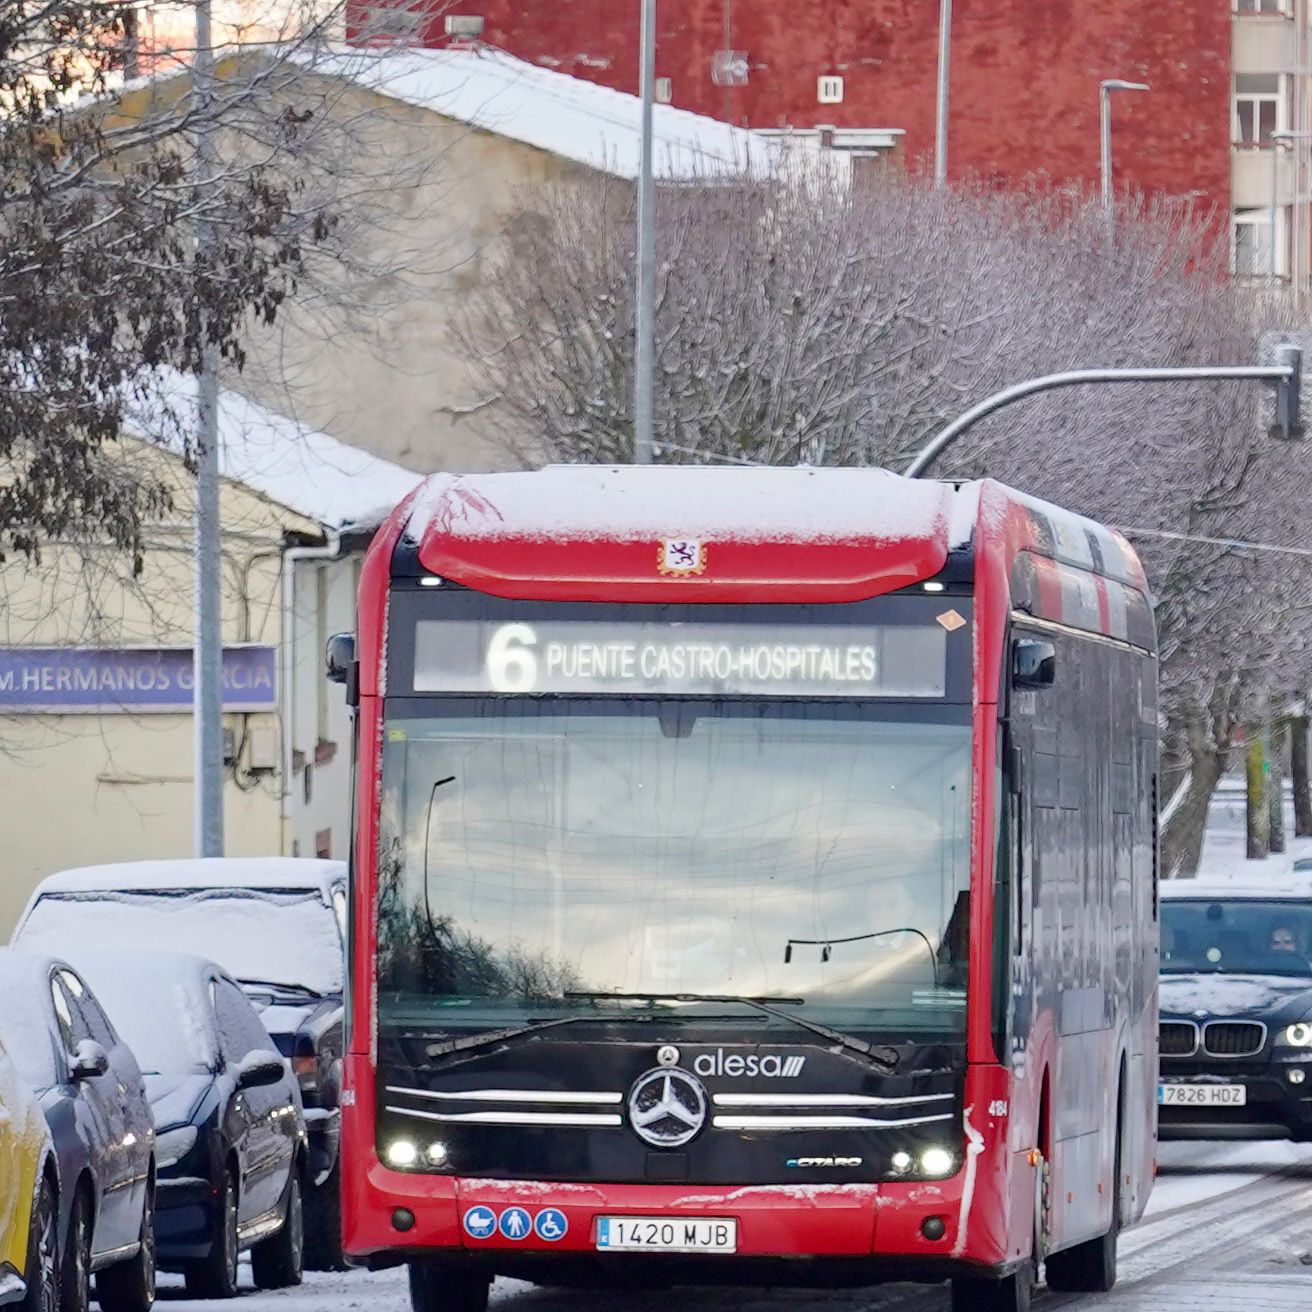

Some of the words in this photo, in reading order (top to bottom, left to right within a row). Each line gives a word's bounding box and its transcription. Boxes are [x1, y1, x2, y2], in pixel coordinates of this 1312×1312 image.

[488, 636, 537, 693] 6
[546, 643, 636, 678] PUENTE
[640, 645, 876, 681] CASTRO-HOSPITALES
[21, 665, 171, 691] HERMANOS
[177, 667, 272, 691] GRCIA
[694, 1048, 782, 1078] alesa
[1167, 1088, 1206, 1102] 7826
[1211, 1088, 1241, 1102] HDZ
[617, 1223, 674, 1245] 1420
[684, 1224, 728, 1246] MJB
